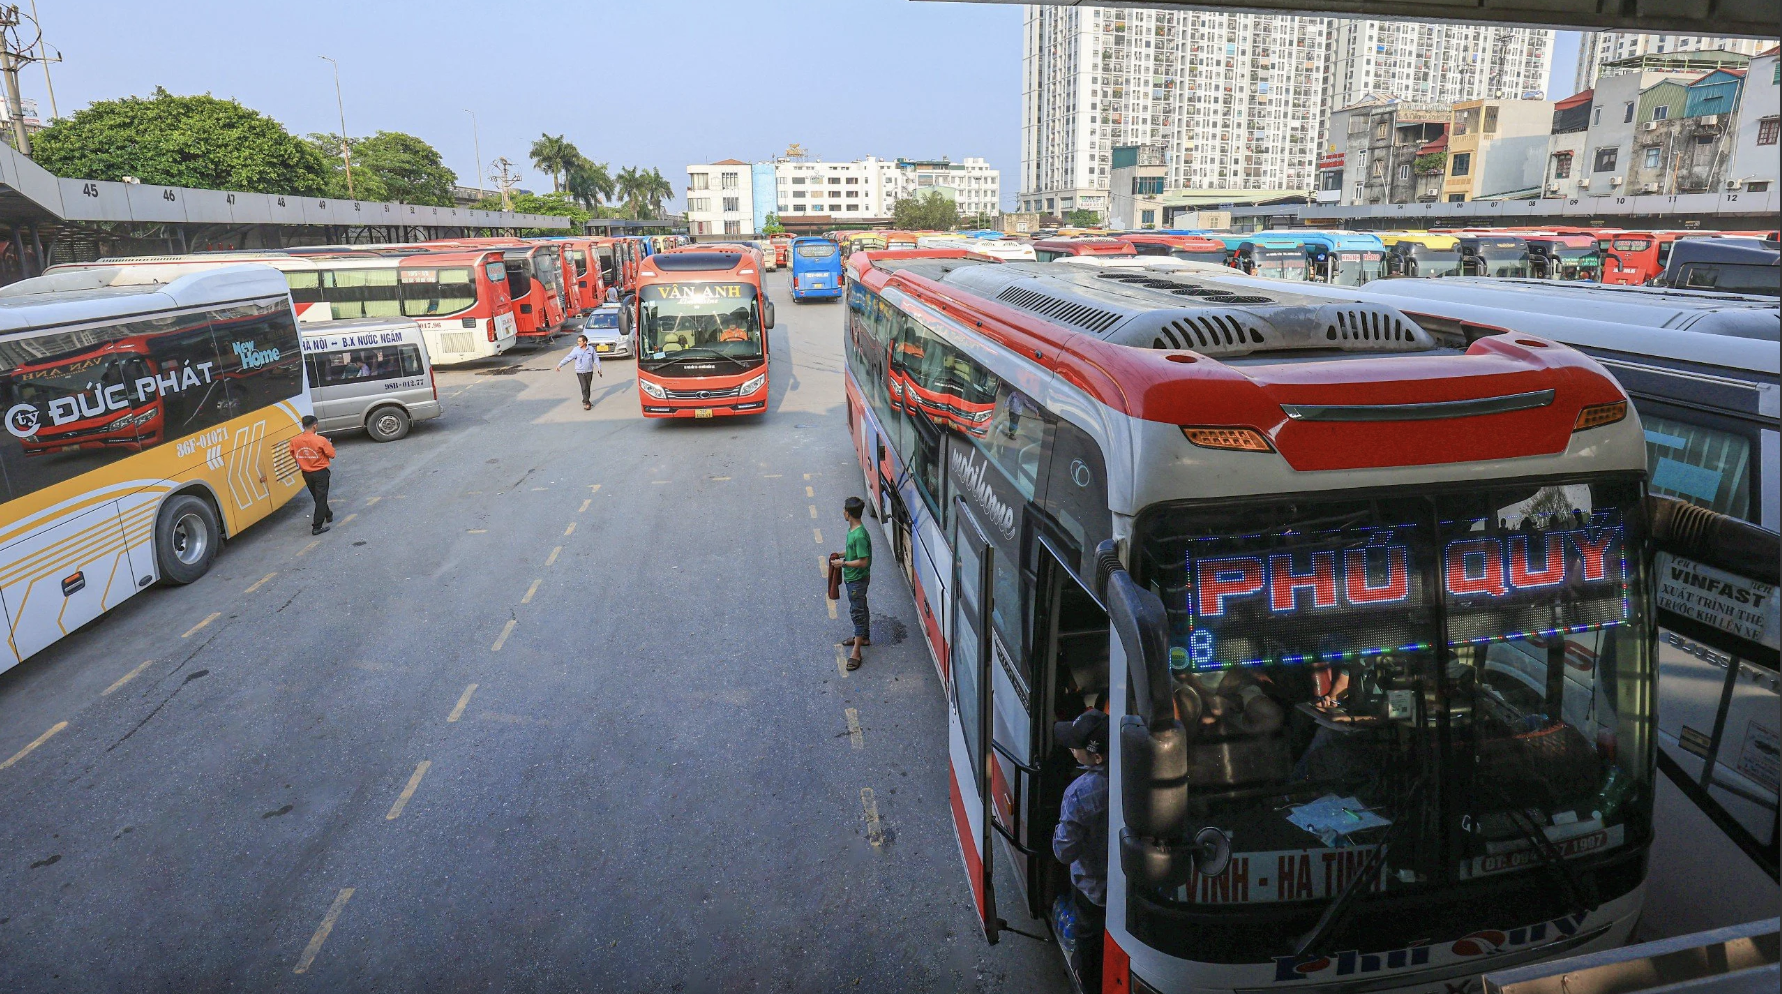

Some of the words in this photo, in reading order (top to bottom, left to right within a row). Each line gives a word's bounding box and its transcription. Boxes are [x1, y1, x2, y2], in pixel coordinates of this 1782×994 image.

[82, 182, 99, 198] 45
[163, 189, 175, 202] 46
[1726, 194, 1738, 202] 12
[226, 194, 236, 205] 47
[277, 197, 286, 208] 48
[319, 200, 326, 210] 49
[1616, 197, 1626, 205] 10
[657, 283, 696, 299] VÂN
[702, 285, 741, 298] ANH
[231, 340, 254, 356] New
[240, 347, 280, 369] Home
[48, 381, 129, 427] ĐỨC
[135, 359, 214, 403] PHÁT
[176, 426, 229, 458] 36F-01071
[1196, 530, 1409, 618] PHÚ
[1671, 566, 1766, 608] VINFAST
[1696, 609, 1717, 624] KHI
[1185, 857, 1249, 904] VINH
[1278, 847, 1314, 901] HÀ
